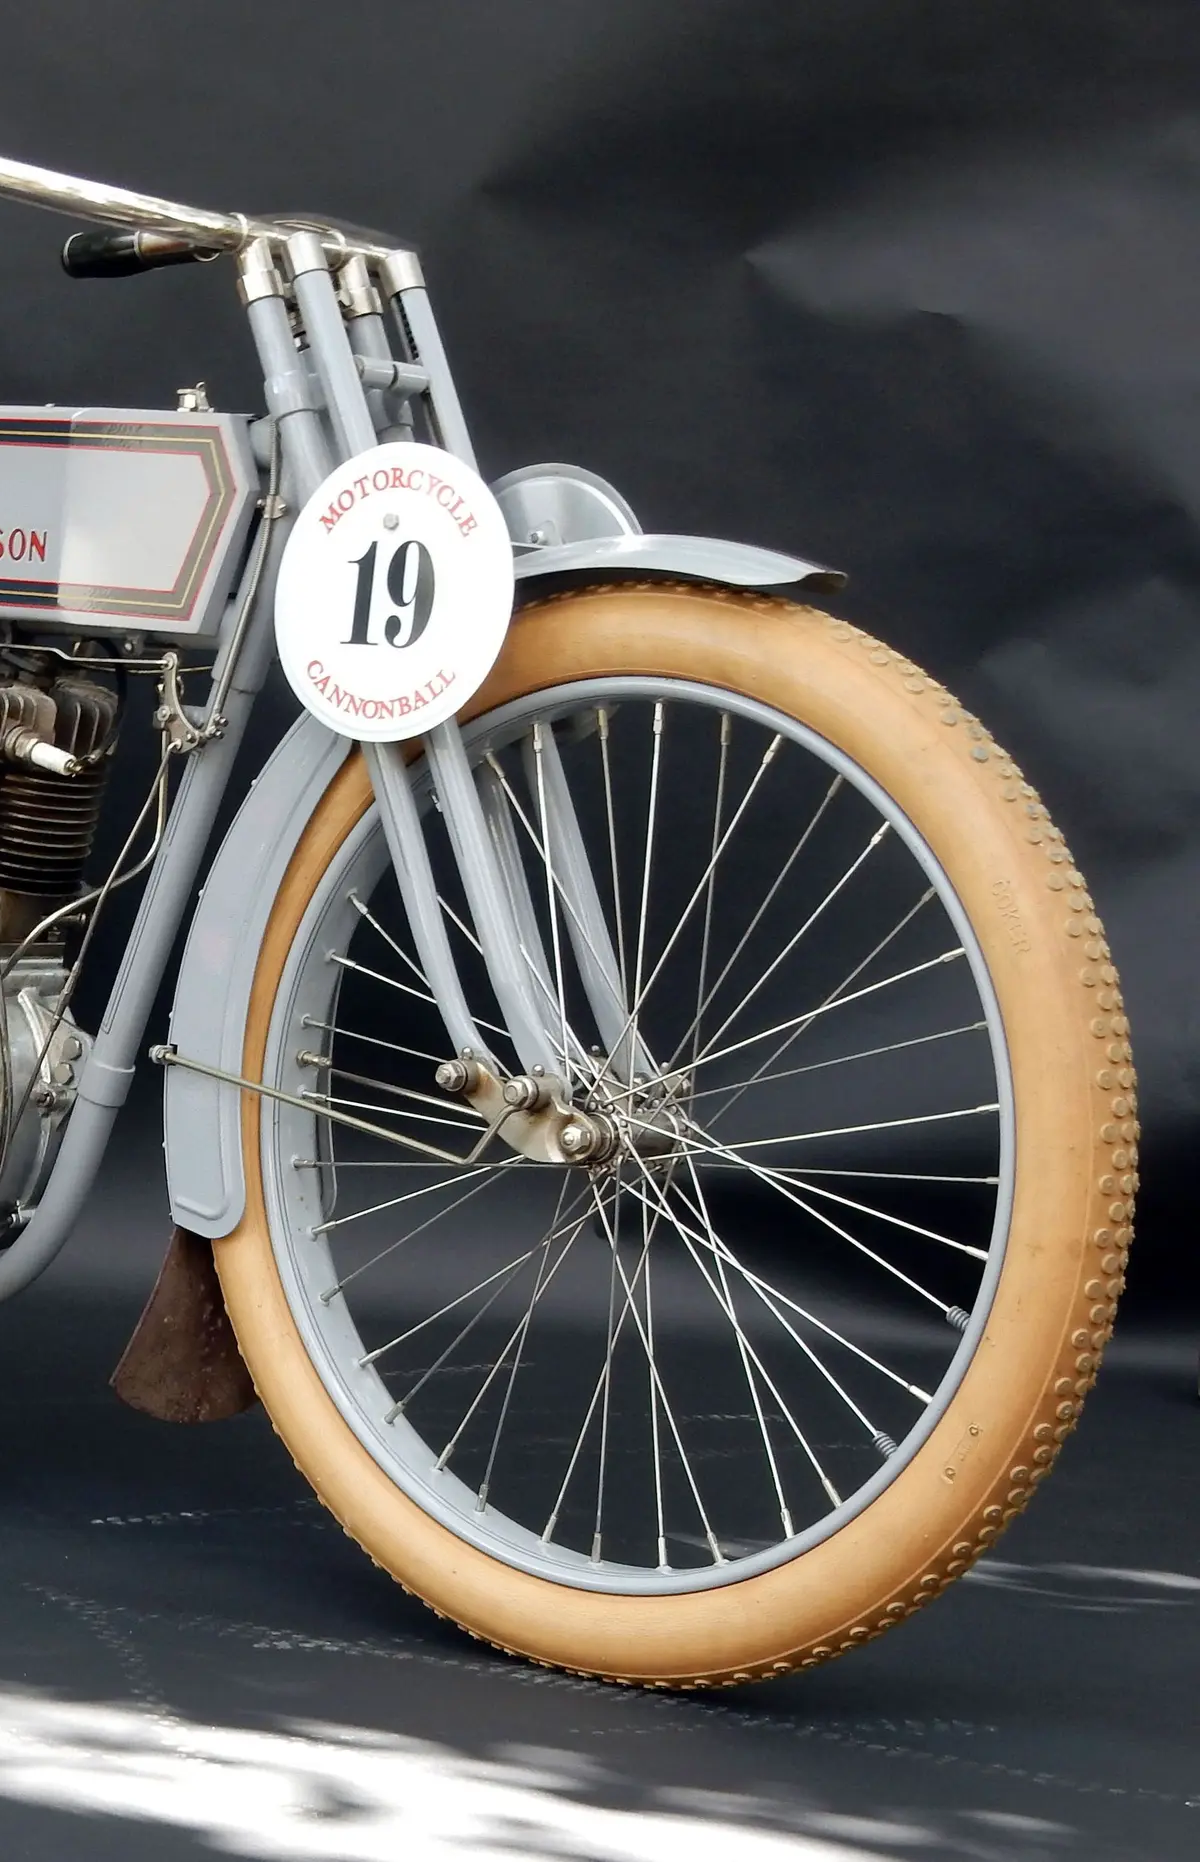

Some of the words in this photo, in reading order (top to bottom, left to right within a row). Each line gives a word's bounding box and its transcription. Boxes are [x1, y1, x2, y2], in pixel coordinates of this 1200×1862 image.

[318, 467, 478, 537] MOTORCYCLE
[339, 540, 435, 648] 19
[306, 660, 456, 719] CANNONBALL
